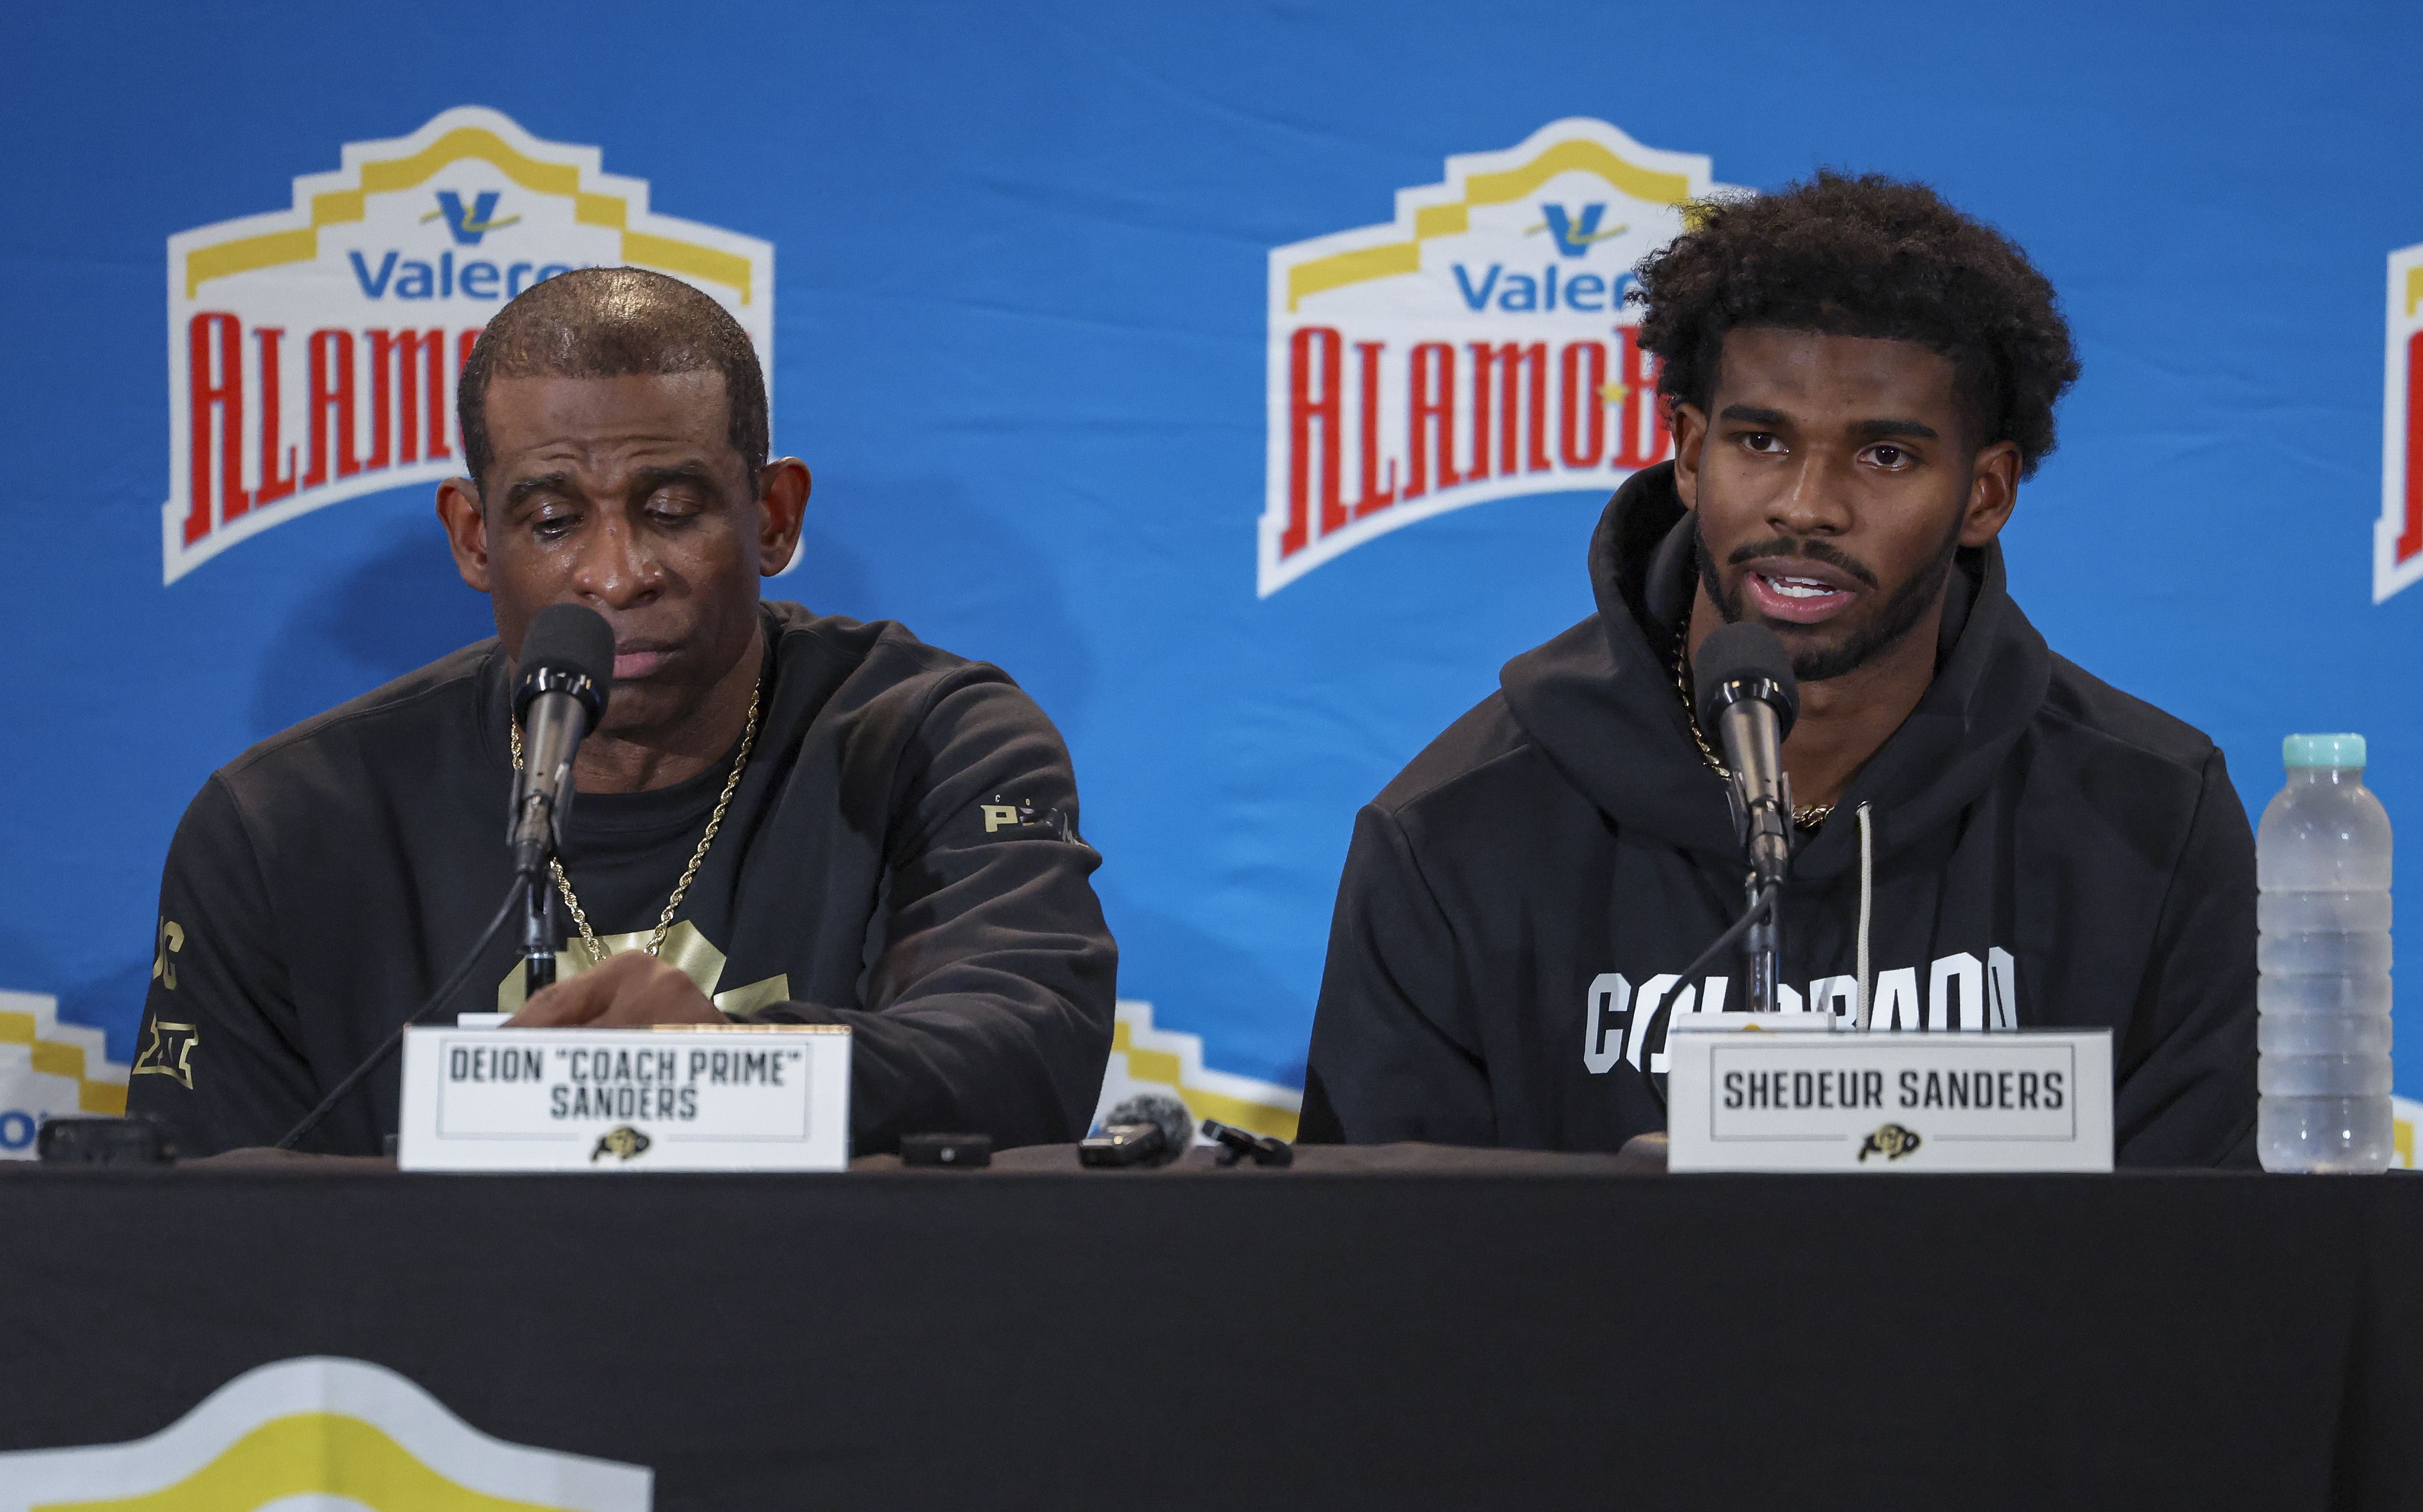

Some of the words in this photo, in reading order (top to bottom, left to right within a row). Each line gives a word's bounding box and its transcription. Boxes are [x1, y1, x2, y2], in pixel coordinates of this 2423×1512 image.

[1451, 264, 1640, 312] Valer
[184, 311, 486, 548] ALAM
[449, 1046, 541, 1083] DEION
[550, 1084, 697, 1121] SANDERS
[1723, 1071, 1883, 1109] SHEDEUR
[1899, 1071, 2063, 1109] SANDERS
